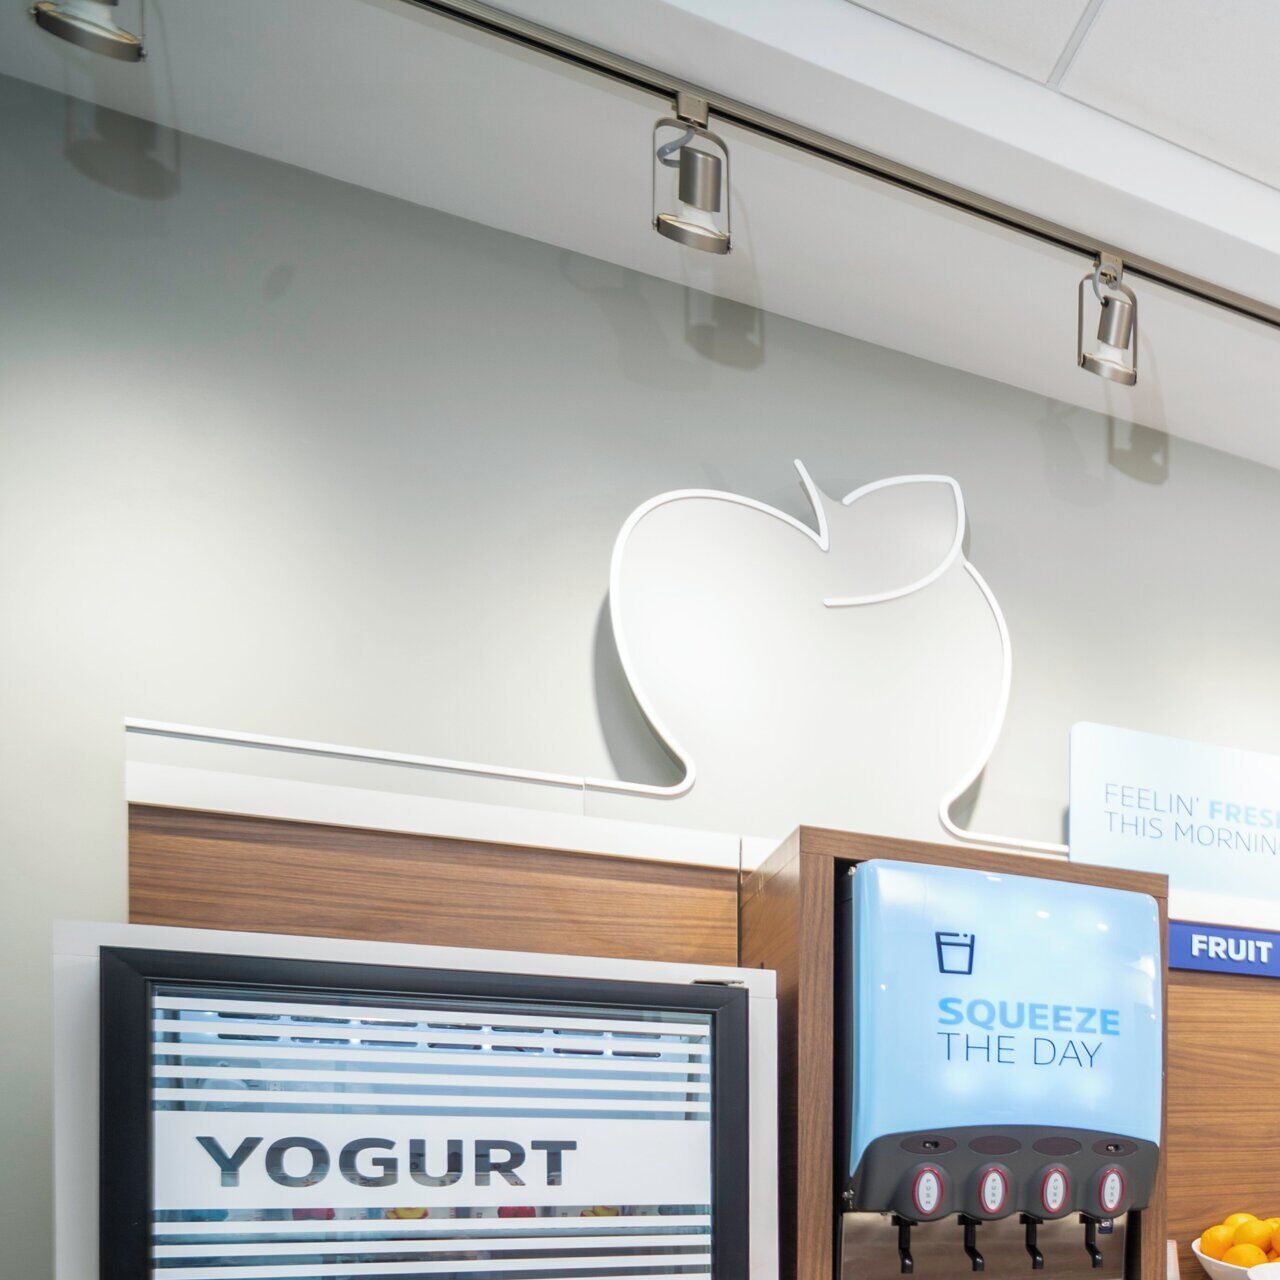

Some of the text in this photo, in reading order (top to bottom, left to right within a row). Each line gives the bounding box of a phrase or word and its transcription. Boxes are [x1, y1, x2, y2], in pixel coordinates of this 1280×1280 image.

[1104, 782, 1200, 816] FEELIN'
[1104, 810, 1163, 839] THIS
[1191, 933, 1273, 963] FRUIT
[938, 996, 1121, 1036] SQUEEZE
[937, 1032, 1103, 1068] THE DAY
[196, 1136, 577, 1188] YOGURT
